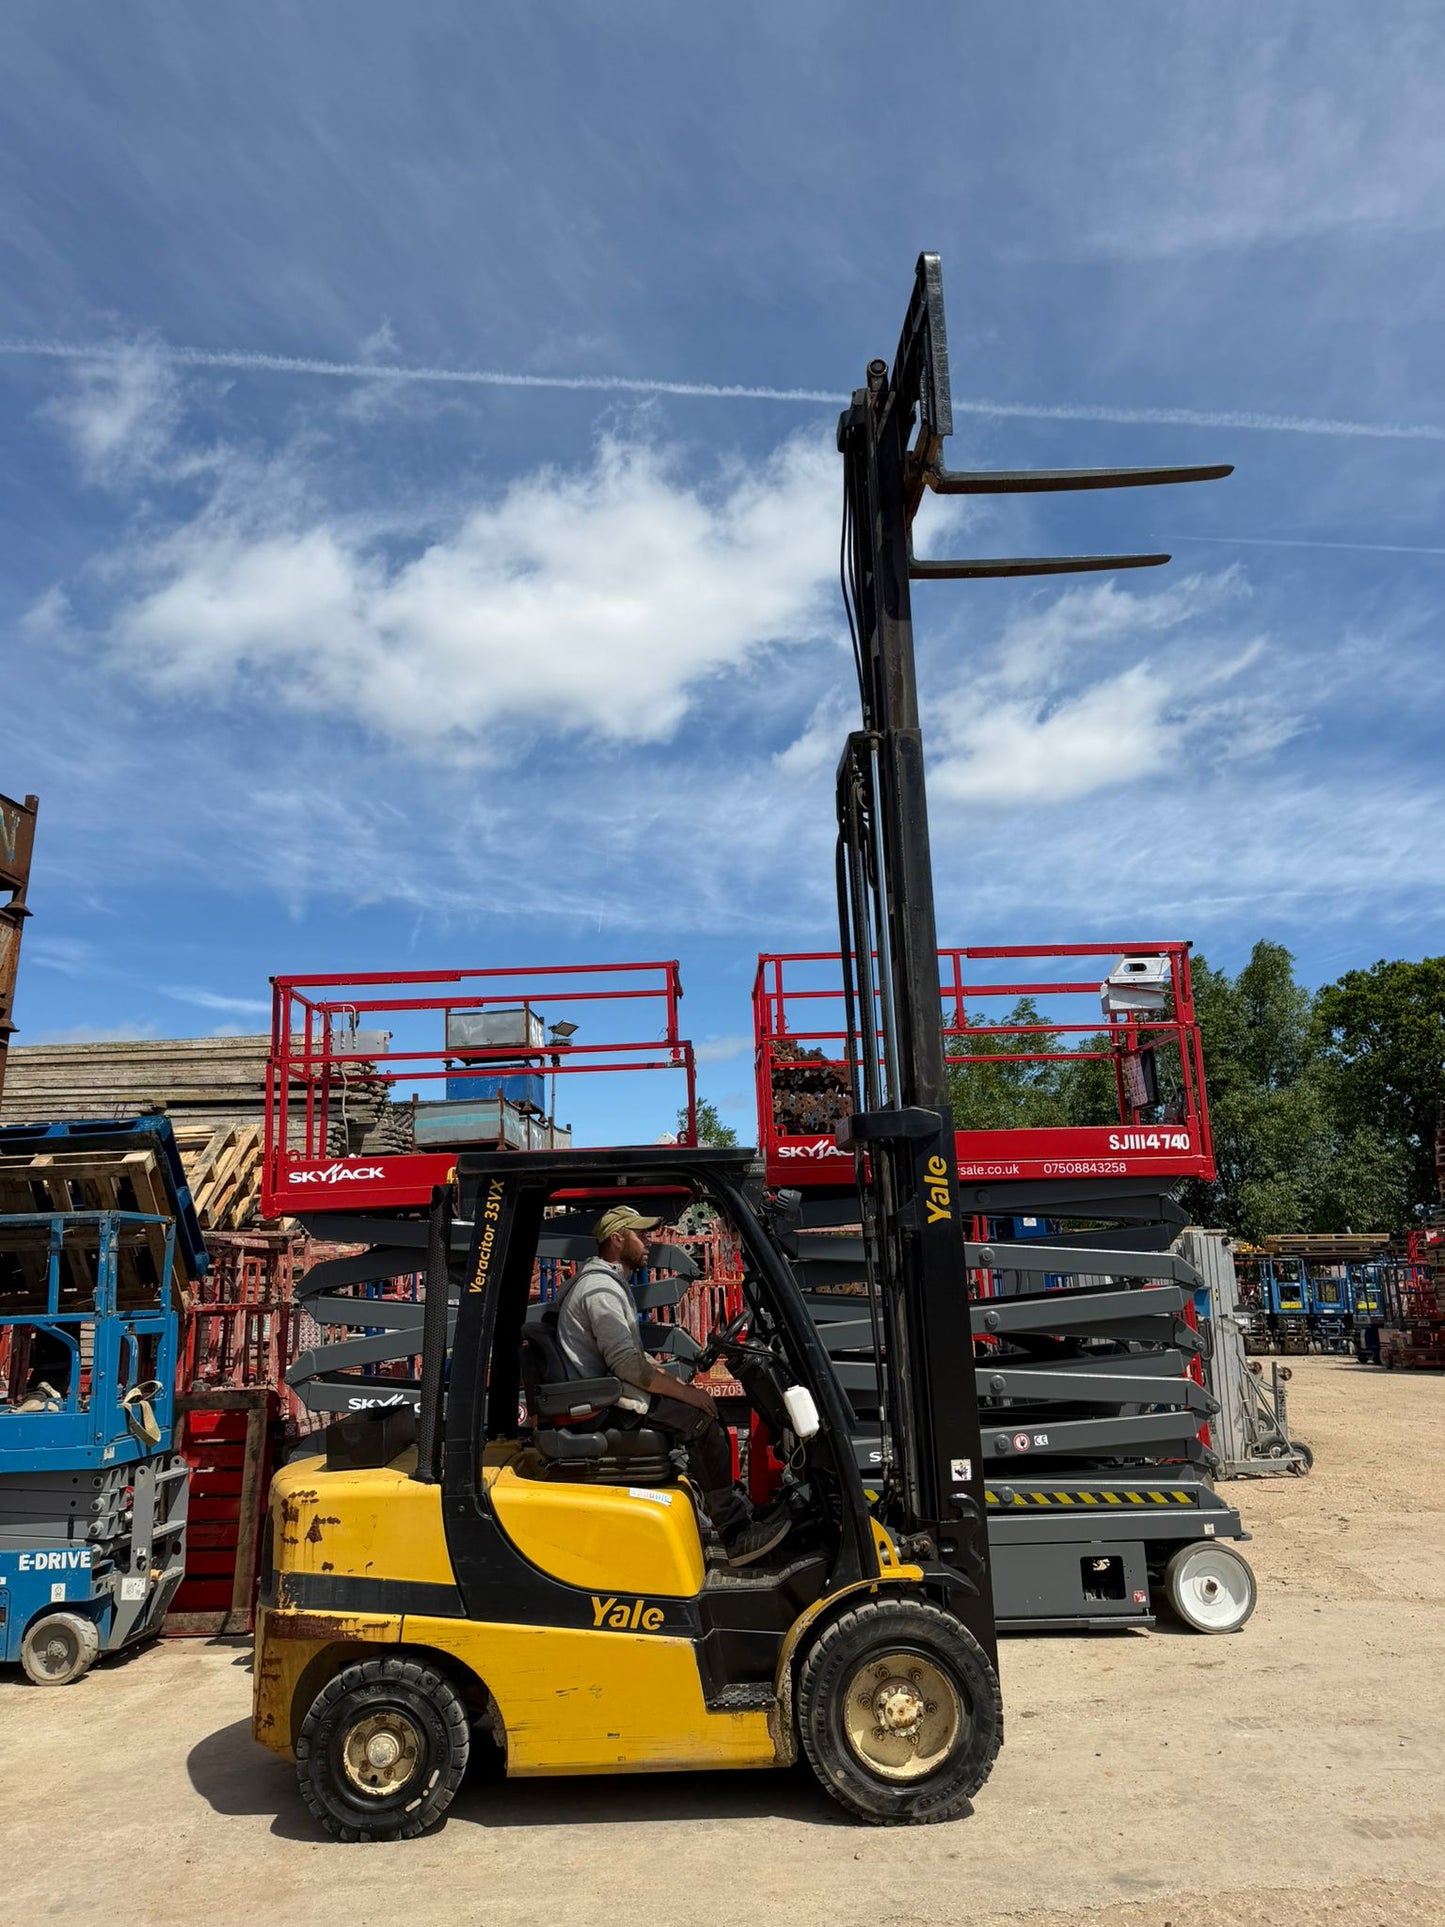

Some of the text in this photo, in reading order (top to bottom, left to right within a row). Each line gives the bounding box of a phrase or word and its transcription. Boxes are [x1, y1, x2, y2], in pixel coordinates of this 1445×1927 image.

[288, 1163, 385, 1184] SKYJACK
[1043, 1162, 1127, 1174] 07508843258
[924, 1155, 952, 1224] Yale
[469, 1178, 505, 1293] Veracitor 35VX
[18, 1550, 91, 1571] E-DRIVE
[591, 1596, 665, 1631] Yale
